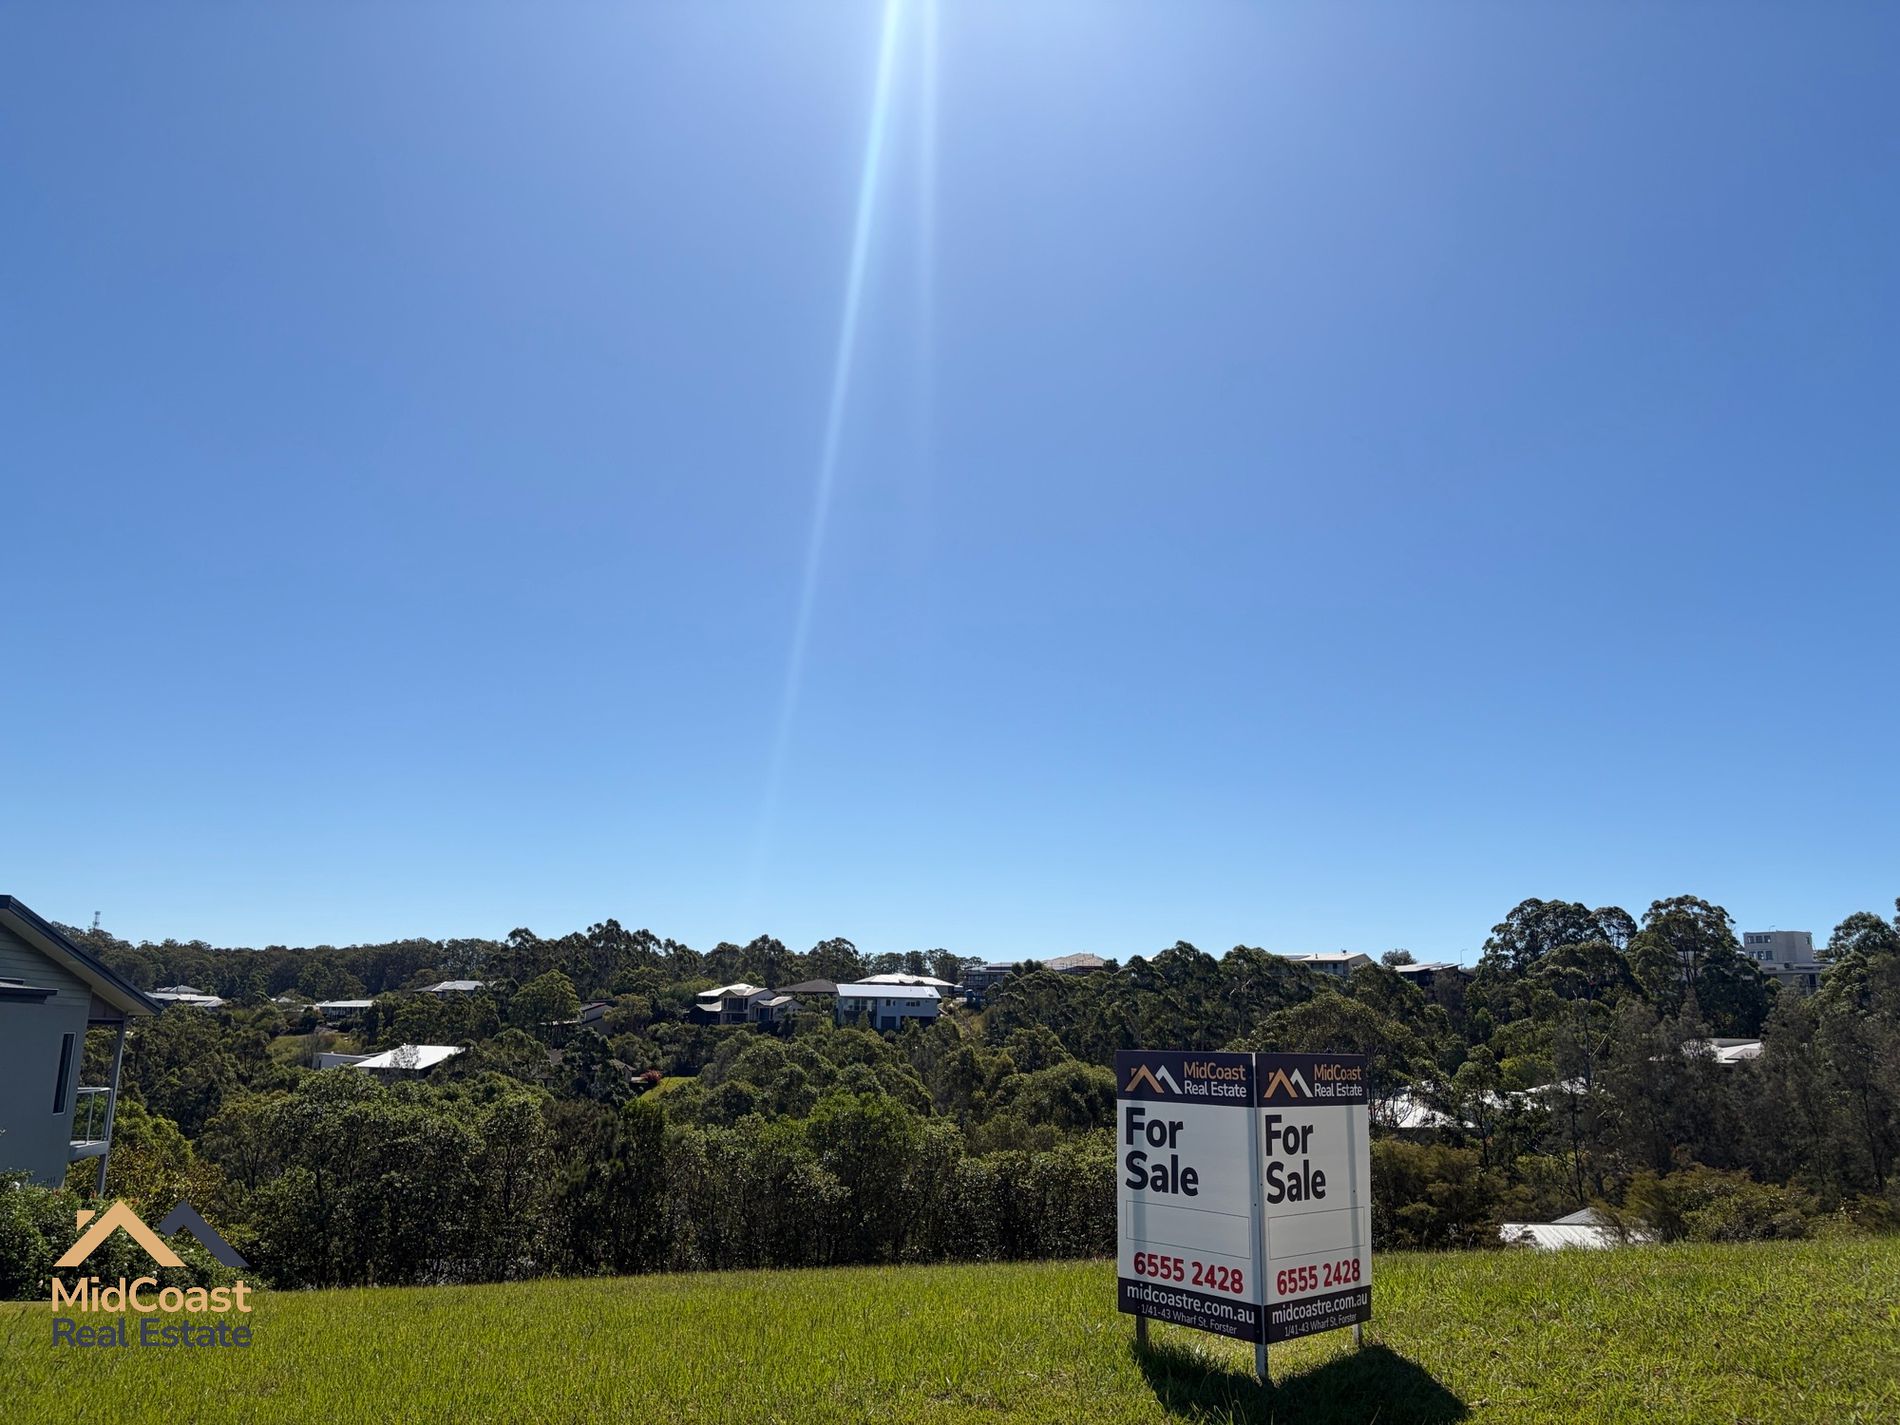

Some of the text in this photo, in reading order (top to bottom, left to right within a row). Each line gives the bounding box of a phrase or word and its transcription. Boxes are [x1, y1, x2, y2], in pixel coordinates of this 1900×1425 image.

[1184, 1061, 1246, 1081] MidCoast
[1314, 1064, 1361, 1081] MidCoast
[1184, 1082, 1247, 1098] Real Estate
[1314, 1083, 1362, 1096] Real Estate
[1126, 1107, 1183, 1149] For
[1265, 1114, 1313, 1156] For
[1125, 1150, 1199, 1196] Sale
[1266, 1160, 1326, 1204] Sale
[1134, 1252, 1244, 1294] 6555 2428
[1277, 1258, 1361, 1295] 6555 2428
[1127, 1284, 1255, 1324] midcoastre.com.au
[1141, 1304, 1171, 1319] 1/41-43
[1173, 1312, 1197, 1325] Wharf
[1210, 1319, 1237, 1334] Forster
[1272, 1292, 1367, 1324] midcoastre.com.au
[1284, 1324, 1309, 1337] 1/41-43
[1310, 1319, 1329, 1330] Wharf
[1338, 1314, 1357, 1325] Forster
